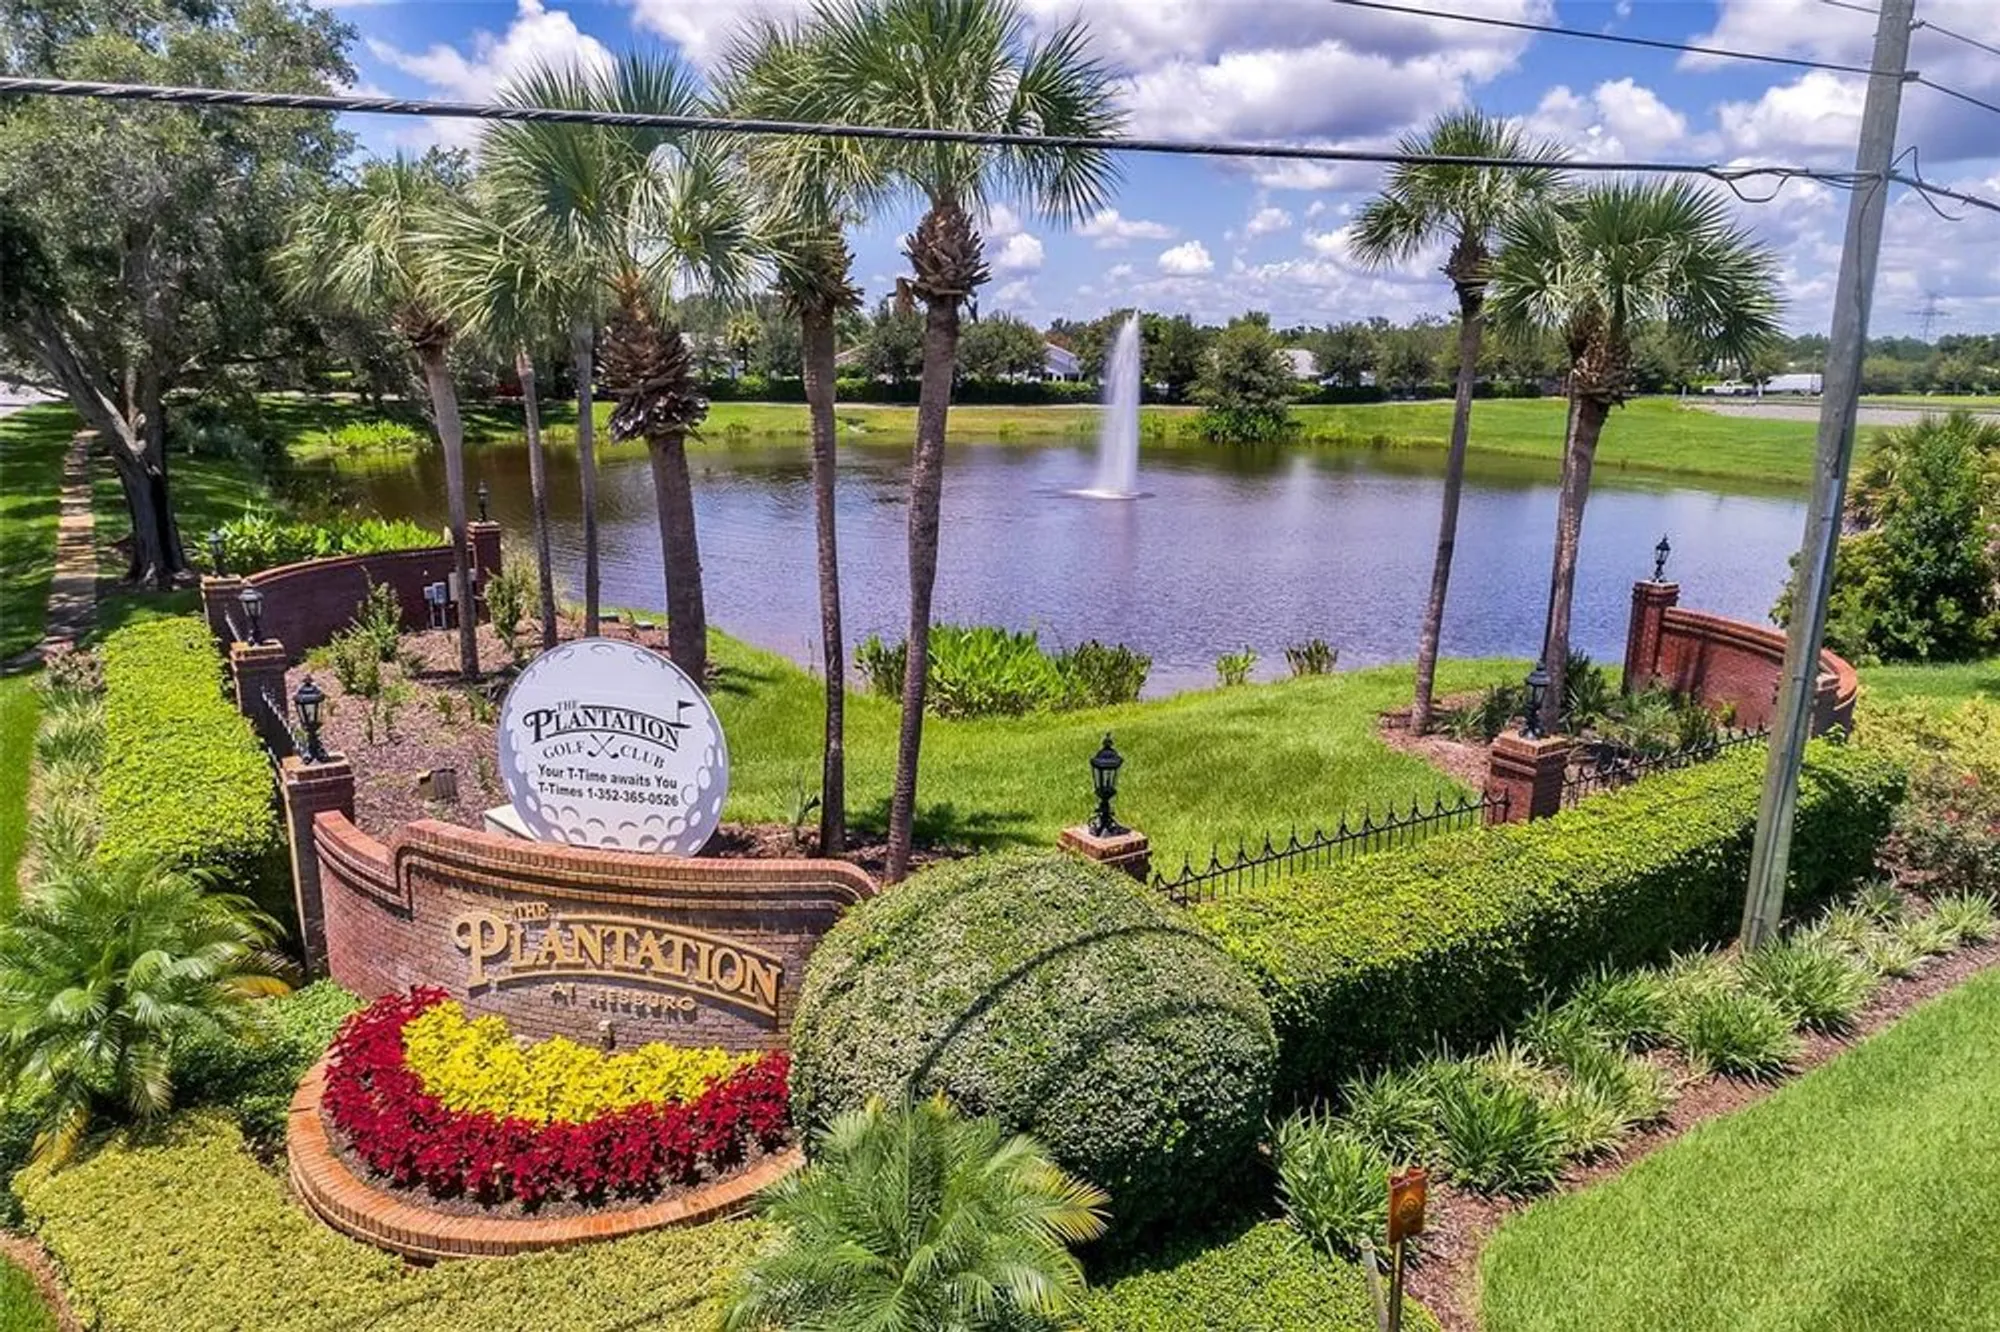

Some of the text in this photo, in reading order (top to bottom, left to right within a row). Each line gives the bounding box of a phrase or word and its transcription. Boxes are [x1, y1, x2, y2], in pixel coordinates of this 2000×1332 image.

[556, 700, 577, 712] THE
[522, 708, 680, 748] PLANTATION
[542, 741, 665, 768] GOLF CLUB
[538, 764, 678, 789] Your T-Time awaits You
[538, 782, 679, 807] T-Times 1-352-365-0526
[513, 901, 550, 921] THE
[450, 911, 783, 1012] PLANTATION
[551, 981, 577, 998] AT
